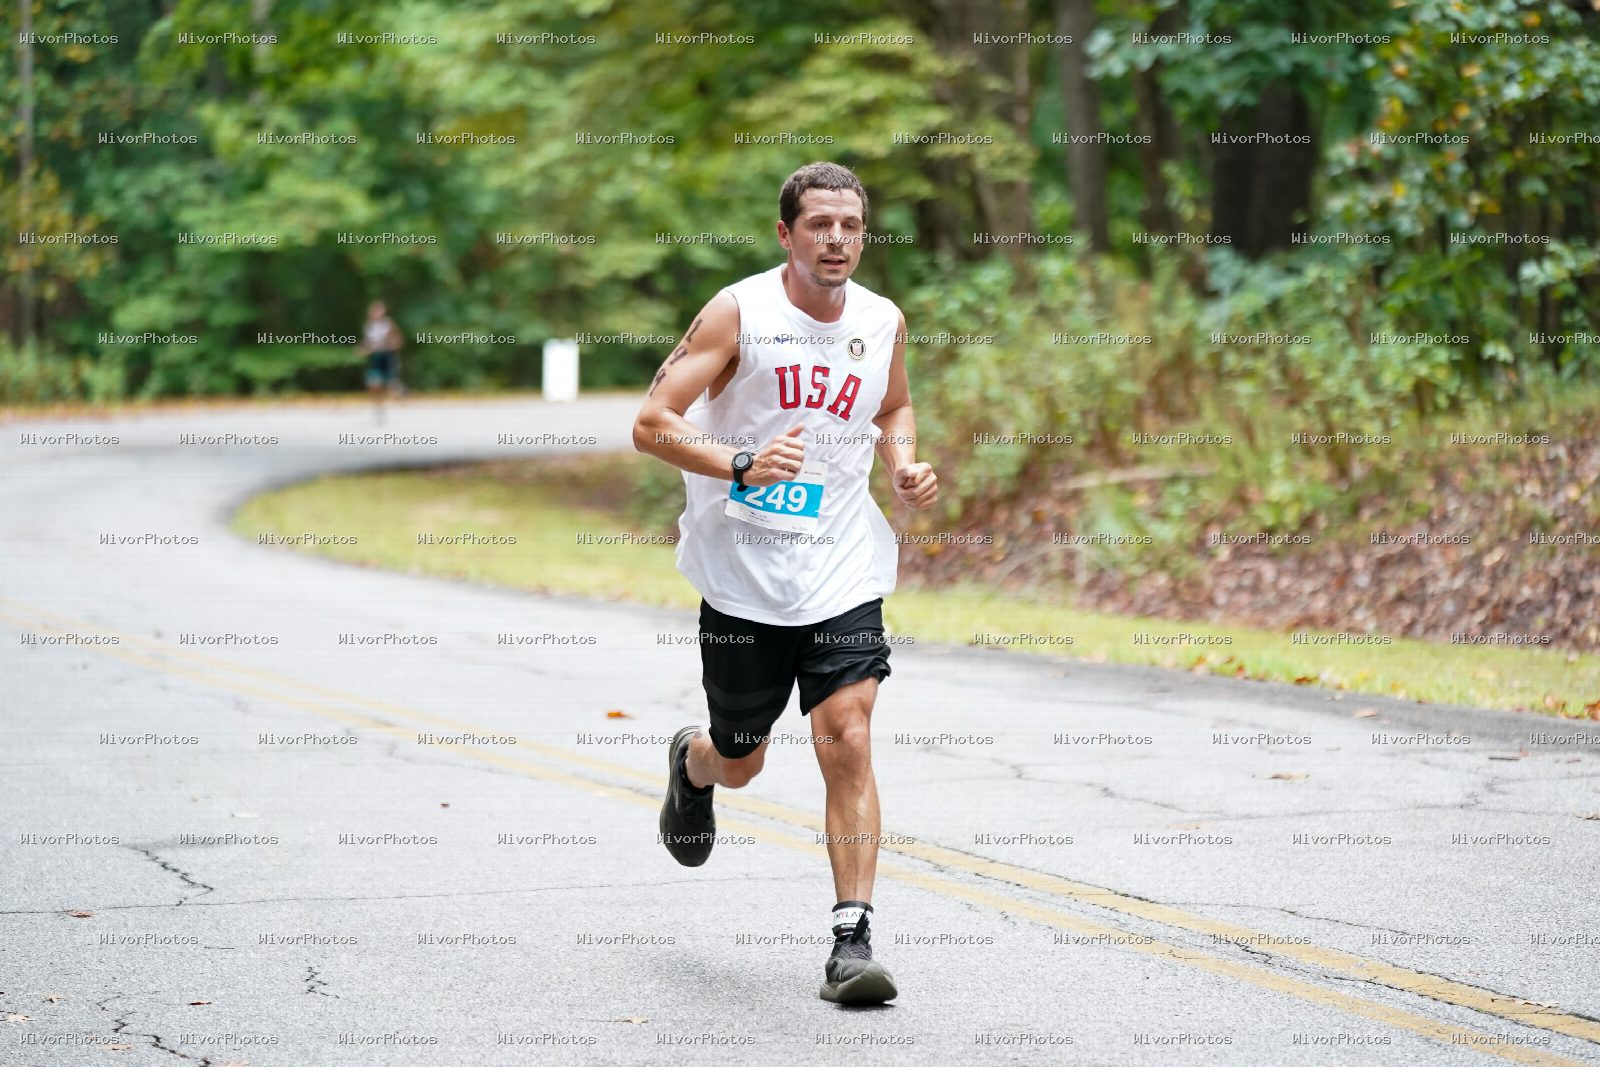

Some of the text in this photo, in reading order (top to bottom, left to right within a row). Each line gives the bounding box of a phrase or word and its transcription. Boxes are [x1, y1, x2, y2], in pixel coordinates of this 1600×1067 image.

[775, 364, 862, 421] USA
[744, 484, 808, 513] 249
[836, 911, 869, 919] MYLA
